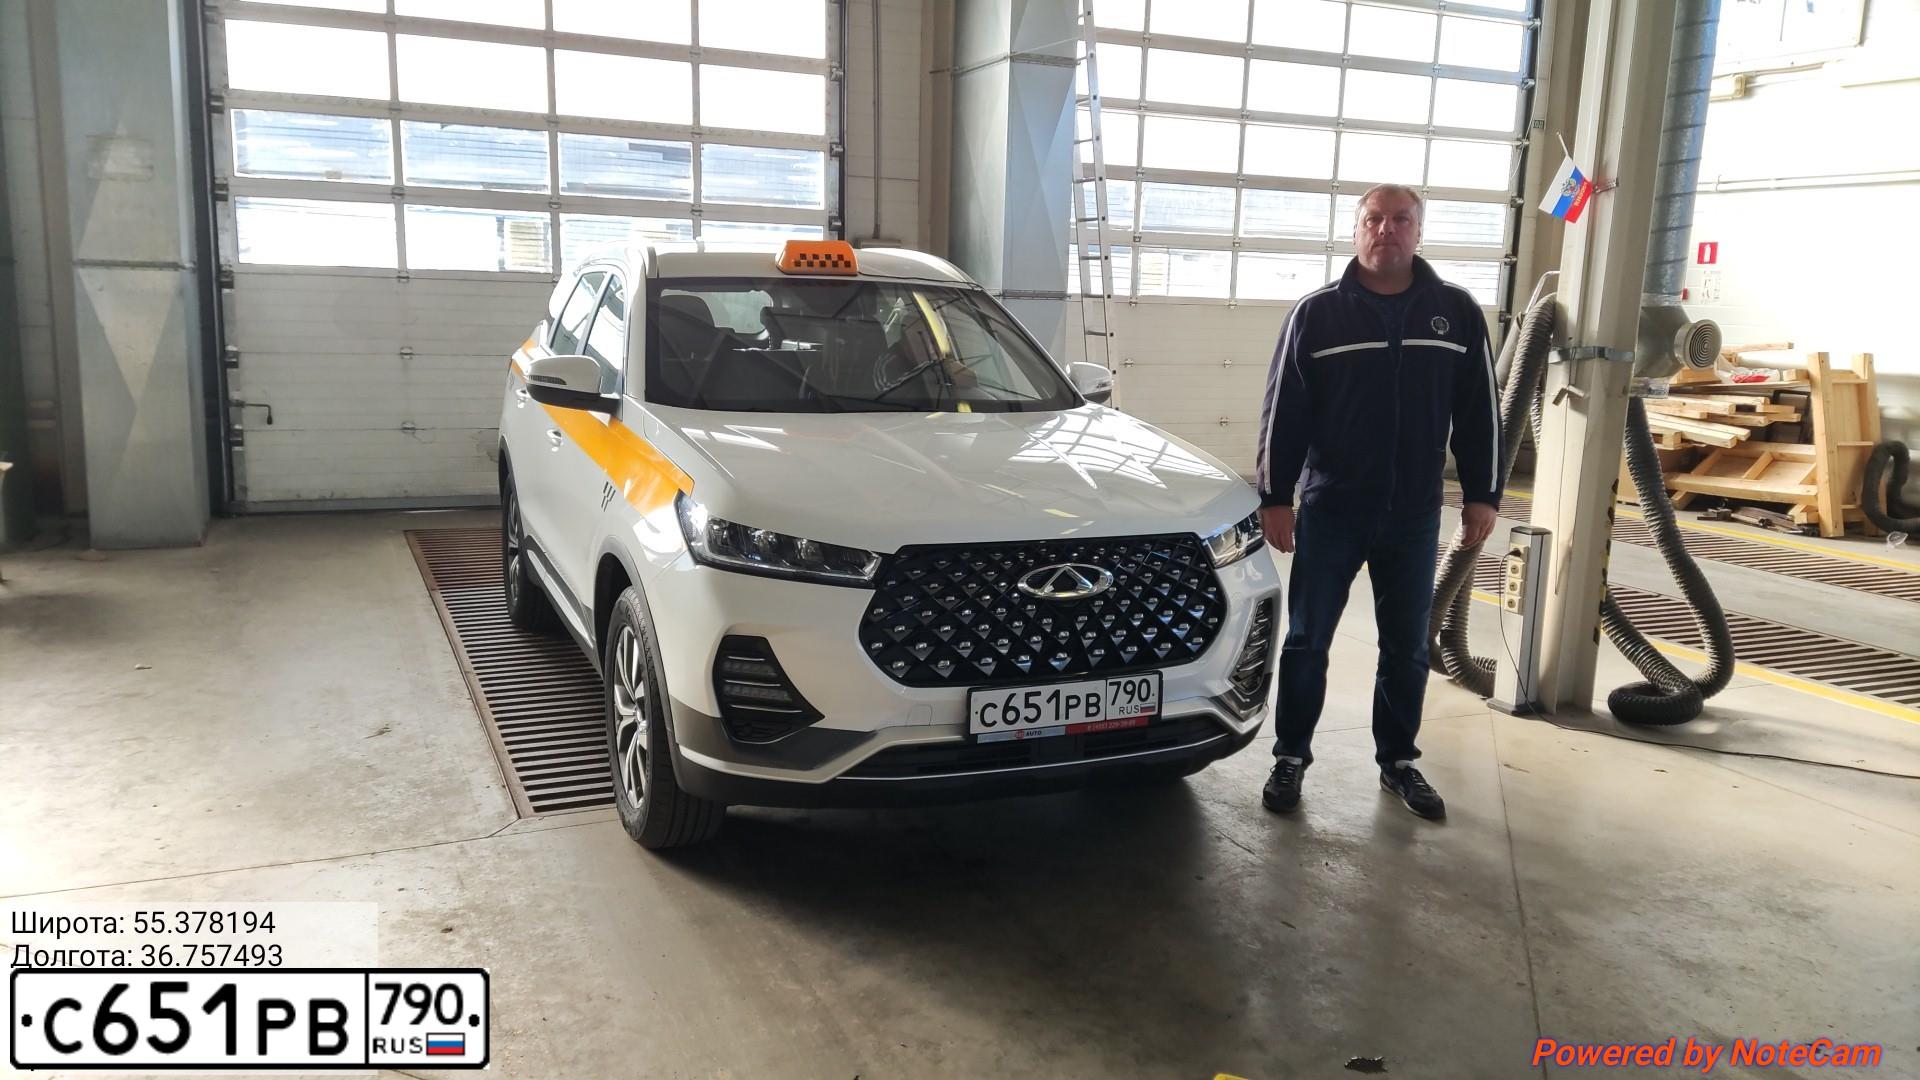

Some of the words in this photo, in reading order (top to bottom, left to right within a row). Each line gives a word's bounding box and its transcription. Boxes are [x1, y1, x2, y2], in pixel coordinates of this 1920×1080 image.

[979, 689, 1101, 728] С651РВ
[1108, 678, 1151, 706] 790
[1119, 706, 1140, 716] RUS
[1025, 730, 1042, 738] AUTO
